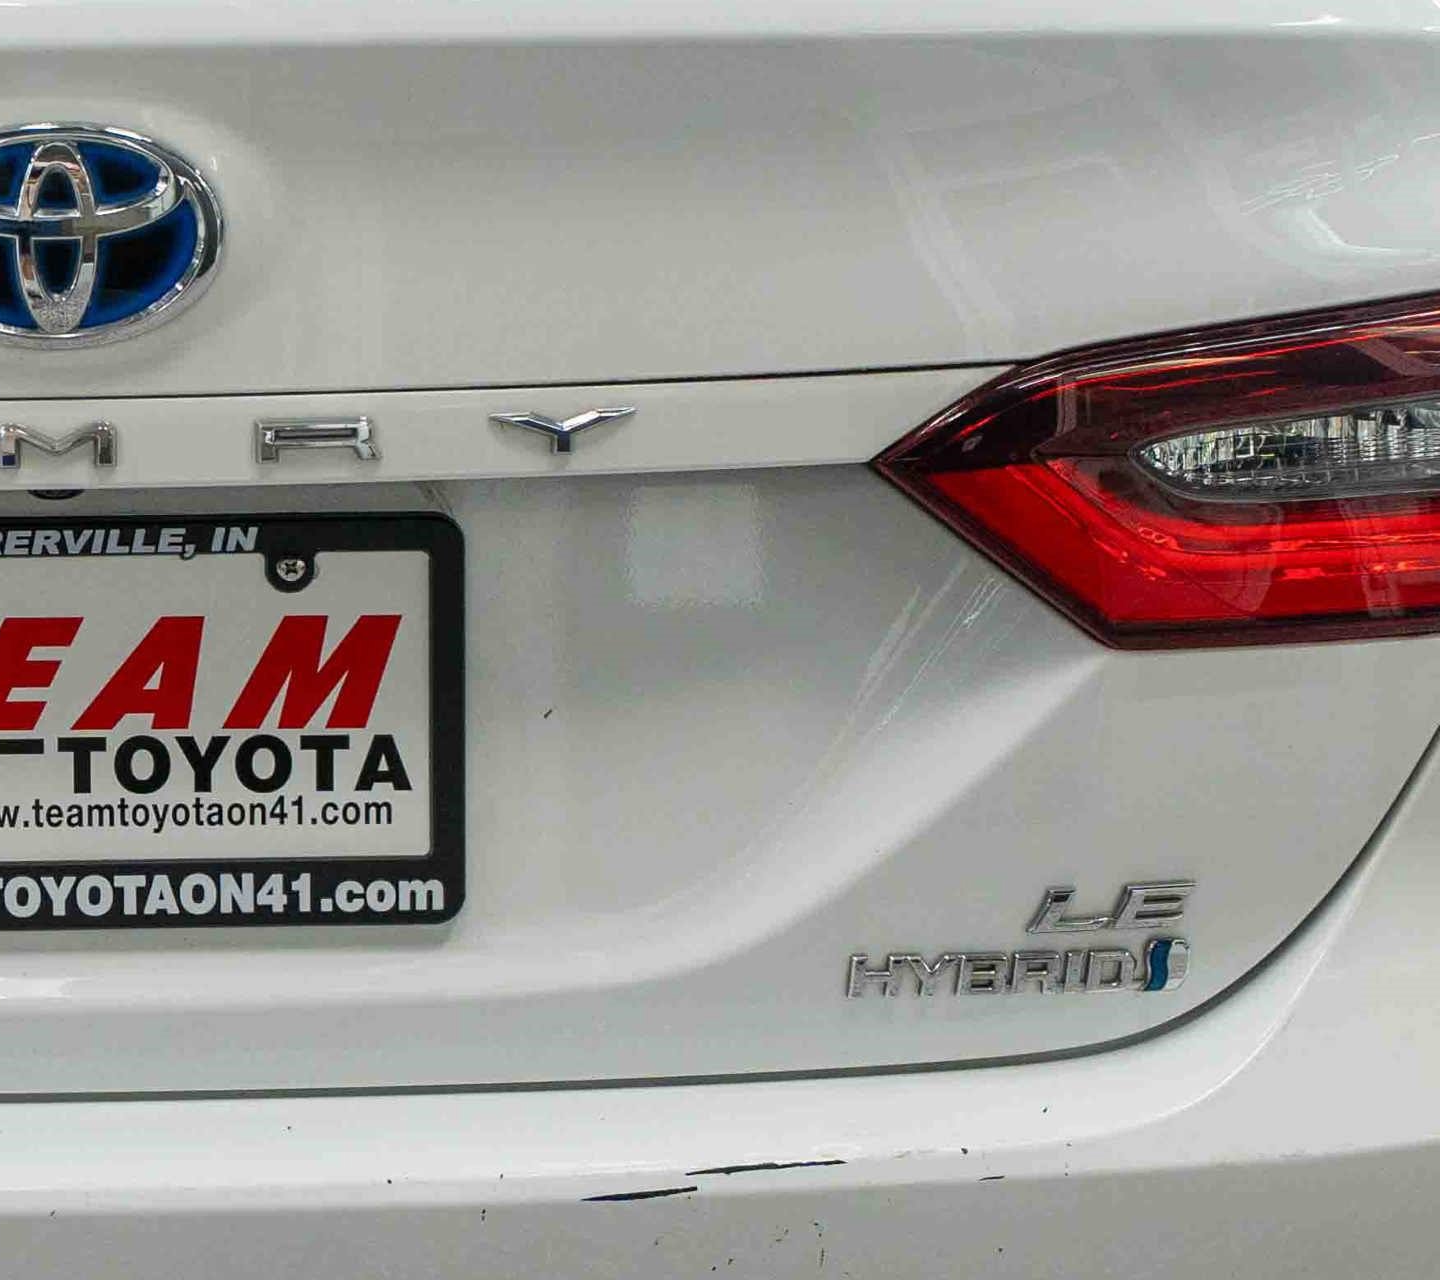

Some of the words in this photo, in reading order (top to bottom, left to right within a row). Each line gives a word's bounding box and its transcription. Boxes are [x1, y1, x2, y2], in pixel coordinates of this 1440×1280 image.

[209, 525, 259, 554] IN
[58, 734, 411, 794] TOYOTA
[1025, 879, 1198, 934] LE
[847, 950, 1136, 1000] HYBRID
